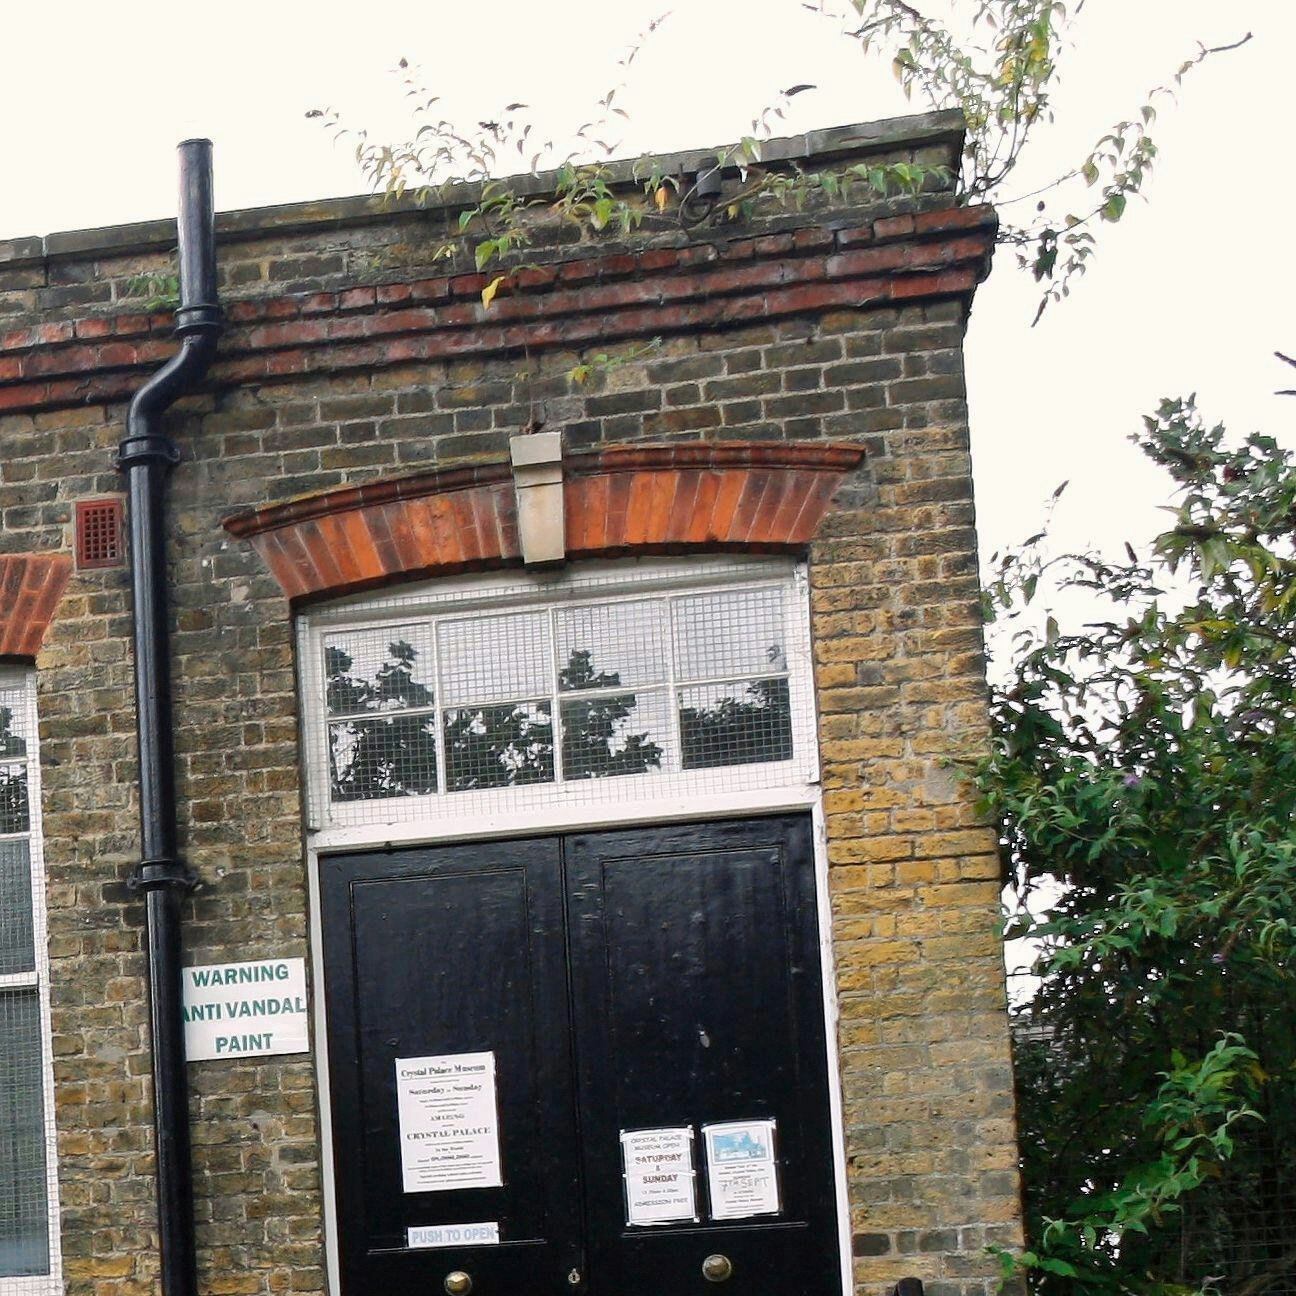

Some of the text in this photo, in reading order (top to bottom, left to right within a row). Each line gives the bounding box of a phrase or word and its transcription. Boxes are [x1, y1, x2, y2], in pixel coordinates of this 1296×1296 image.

[192, 963, 290, 988] WARNING
[225, 996, 307, 1019] VANDAL
[215, 1032, 274, 1054] PAINT
[401, 1067, 427, 1079] Crystal
[454, 1063, 486, 1073] Museum
[406, 1126, 491, 1141] CRYSTAL PALACE
[634, 1153, 683, 1165] SATURDAY
[642, 1173, 679, 1184] SUNDAY
[411, 1227, 495, 1243] PUSH TO OPEN
